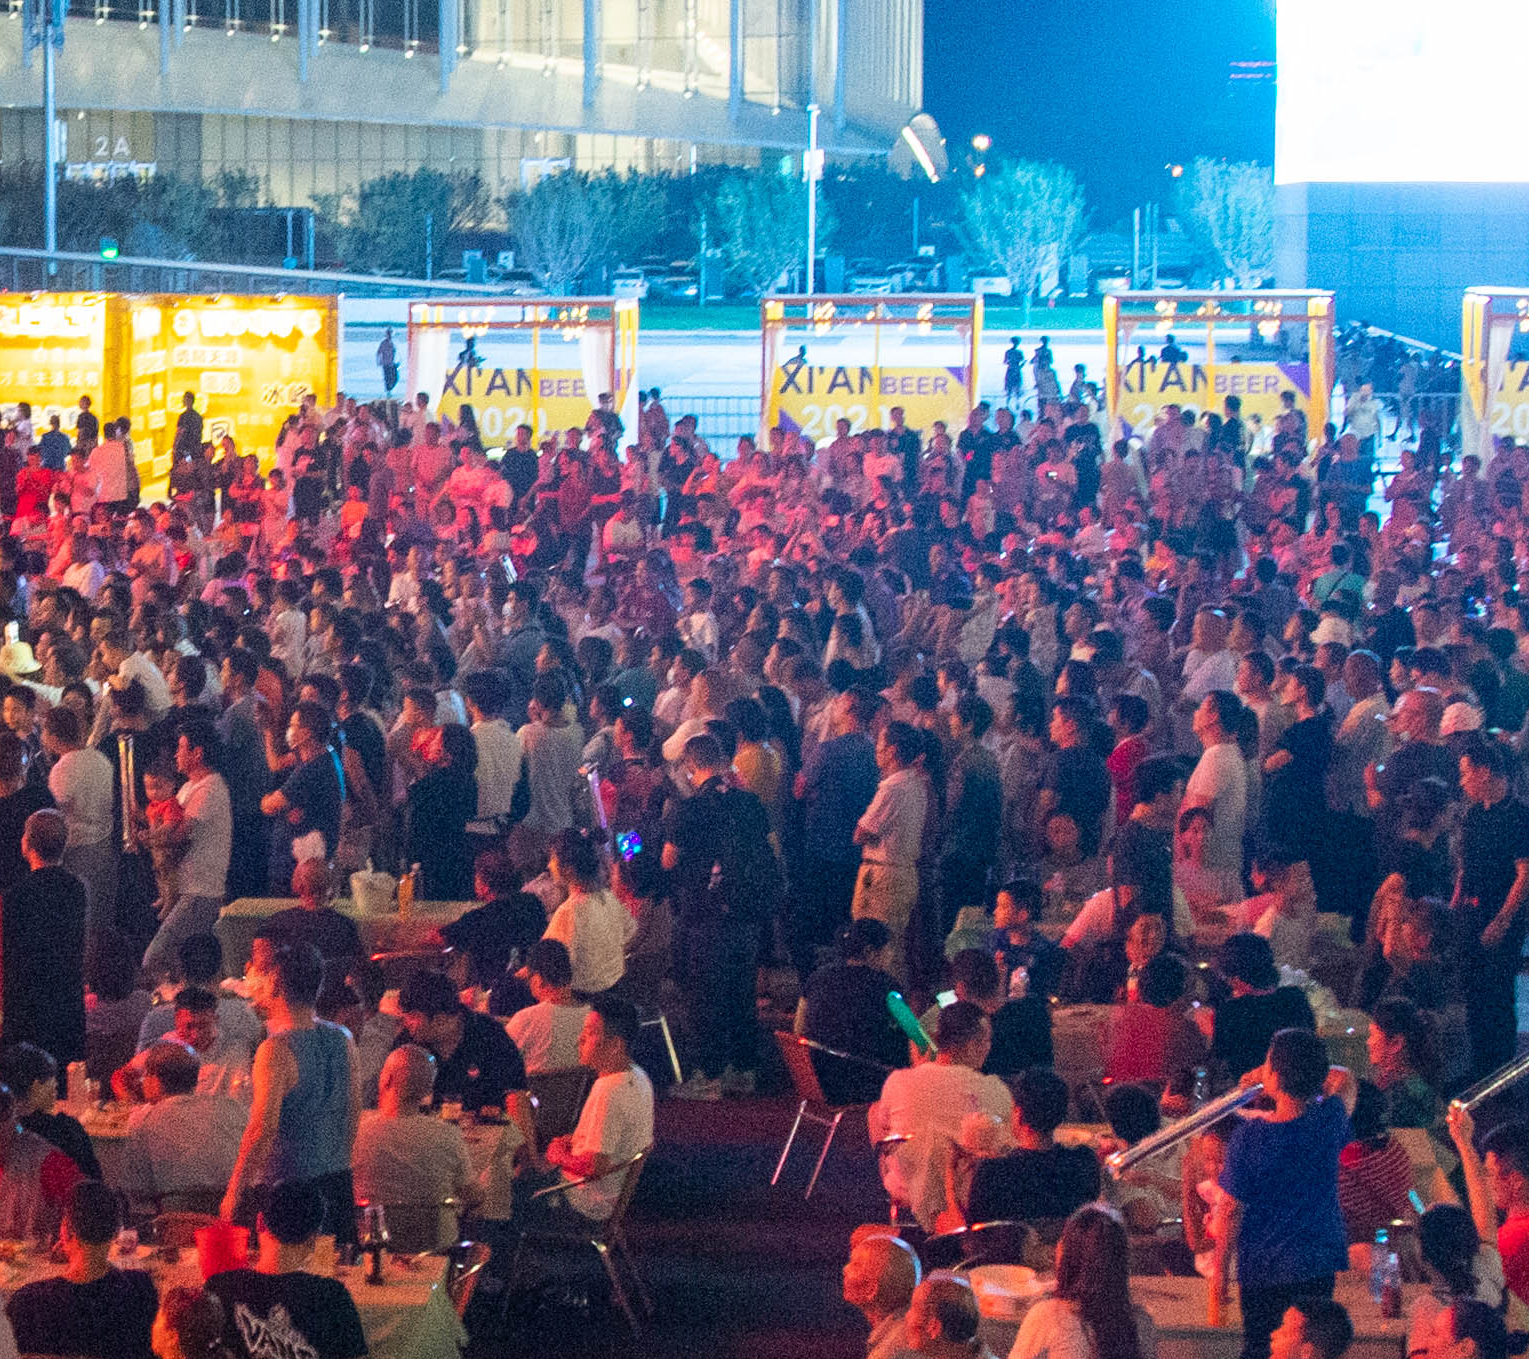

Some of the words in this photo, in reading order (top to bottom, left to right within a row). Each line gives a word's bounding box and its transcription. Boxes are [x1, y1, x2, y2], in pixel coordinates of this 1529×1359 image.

[539, 378, 586, 398] BEE
[880, 376, 949, 396] BEER
[1214, 375, 1280, 394] BEER
